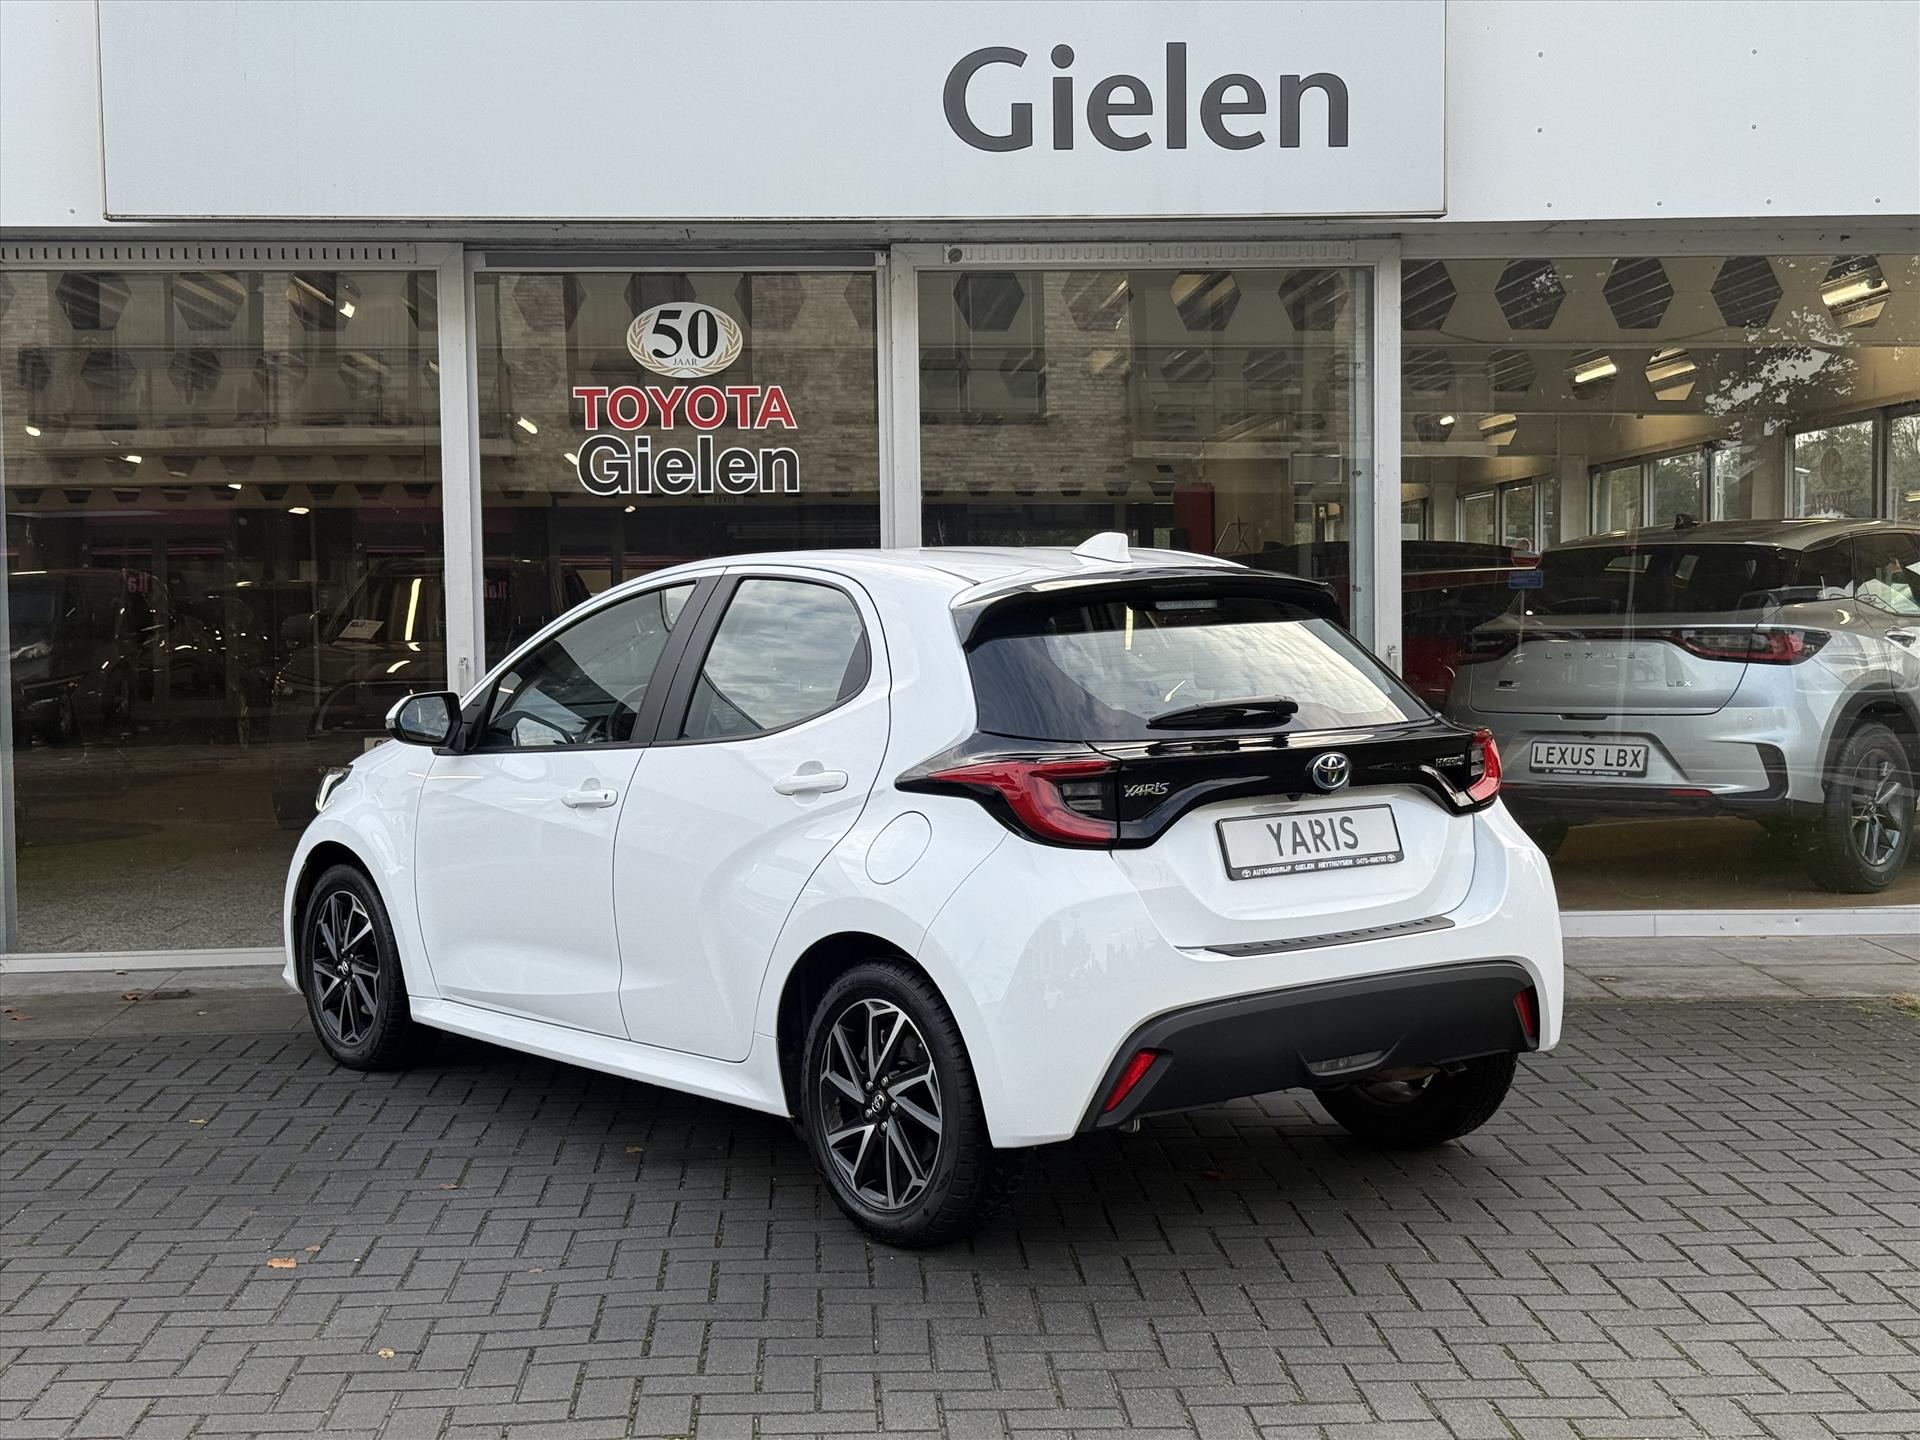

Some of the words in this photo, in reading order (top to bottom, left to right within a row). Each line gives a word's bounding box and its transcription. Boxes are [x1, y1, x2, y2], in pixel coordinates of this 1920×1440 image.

[942, 41, 1349, 153] Gielen
[651, 308, 719, 359] 50
[672, 357, 698, 366] JAAR
[572, 385, 798, 431] TOYOTA
[576, 434, 800, 495] Gielen
[1534, 746, 1596, 766] LEXUS
[1603, 748, 1642, 768] LBX
[1265, 816, 1359, 857] YARIS
[1252, 865, 1292, 877] AUTOBEDRIJF
